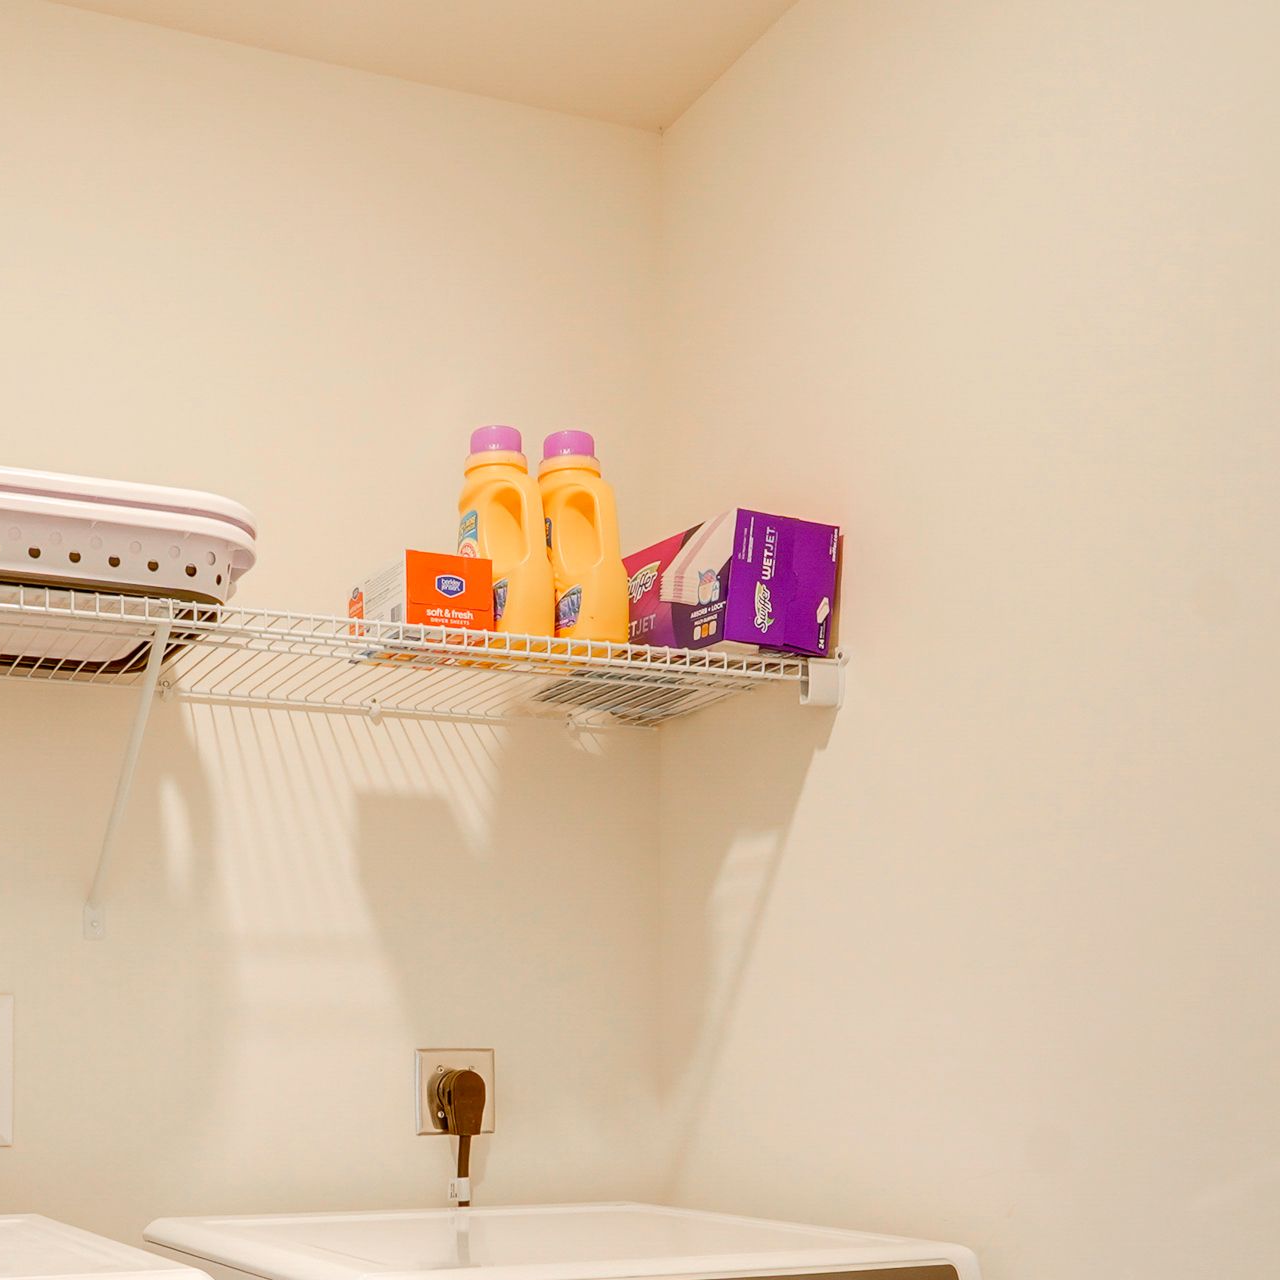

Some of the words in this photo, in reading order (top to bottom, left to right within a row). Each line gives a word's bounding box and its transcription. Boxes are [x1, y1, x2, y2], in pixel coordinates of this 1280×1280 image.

[761, 526, 776, 580] WETJET
[426, 607, 443, 617] soft
[444, 608, 451, 618] &
[451, 609, 474, 620] fresh
[754, 583, 772, 633] Swiffer
